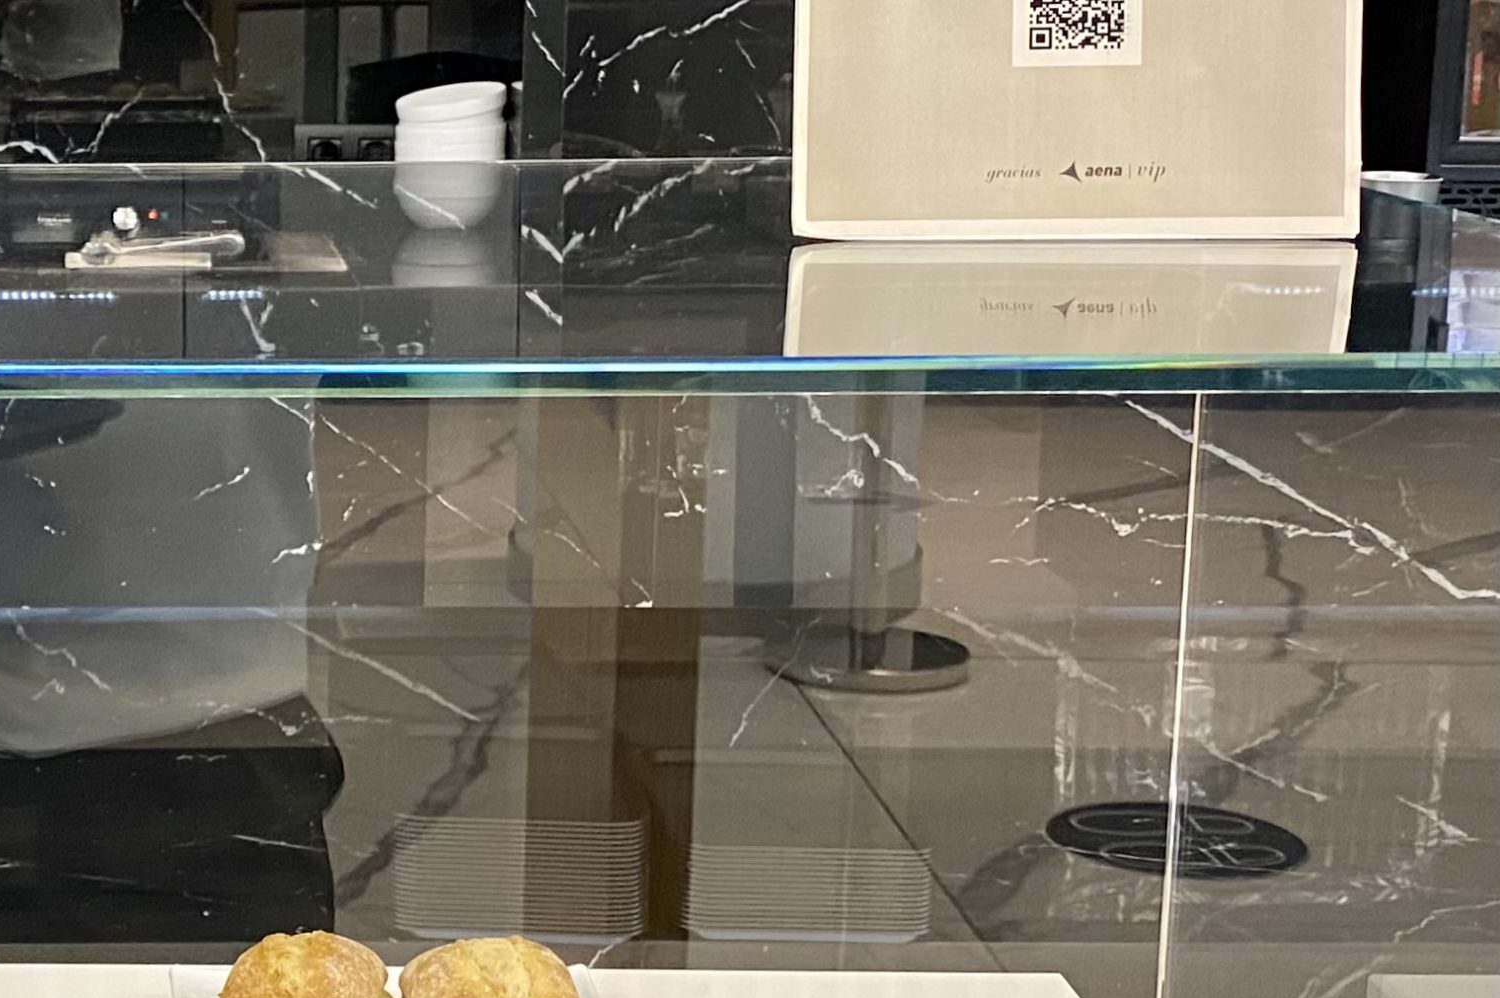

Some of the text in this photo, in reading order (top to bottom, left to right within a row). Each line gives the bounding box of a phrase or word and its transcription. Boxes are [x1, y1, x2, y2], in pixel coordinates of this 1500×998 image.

[985, 161, 1166, 183] gracias aena vip
